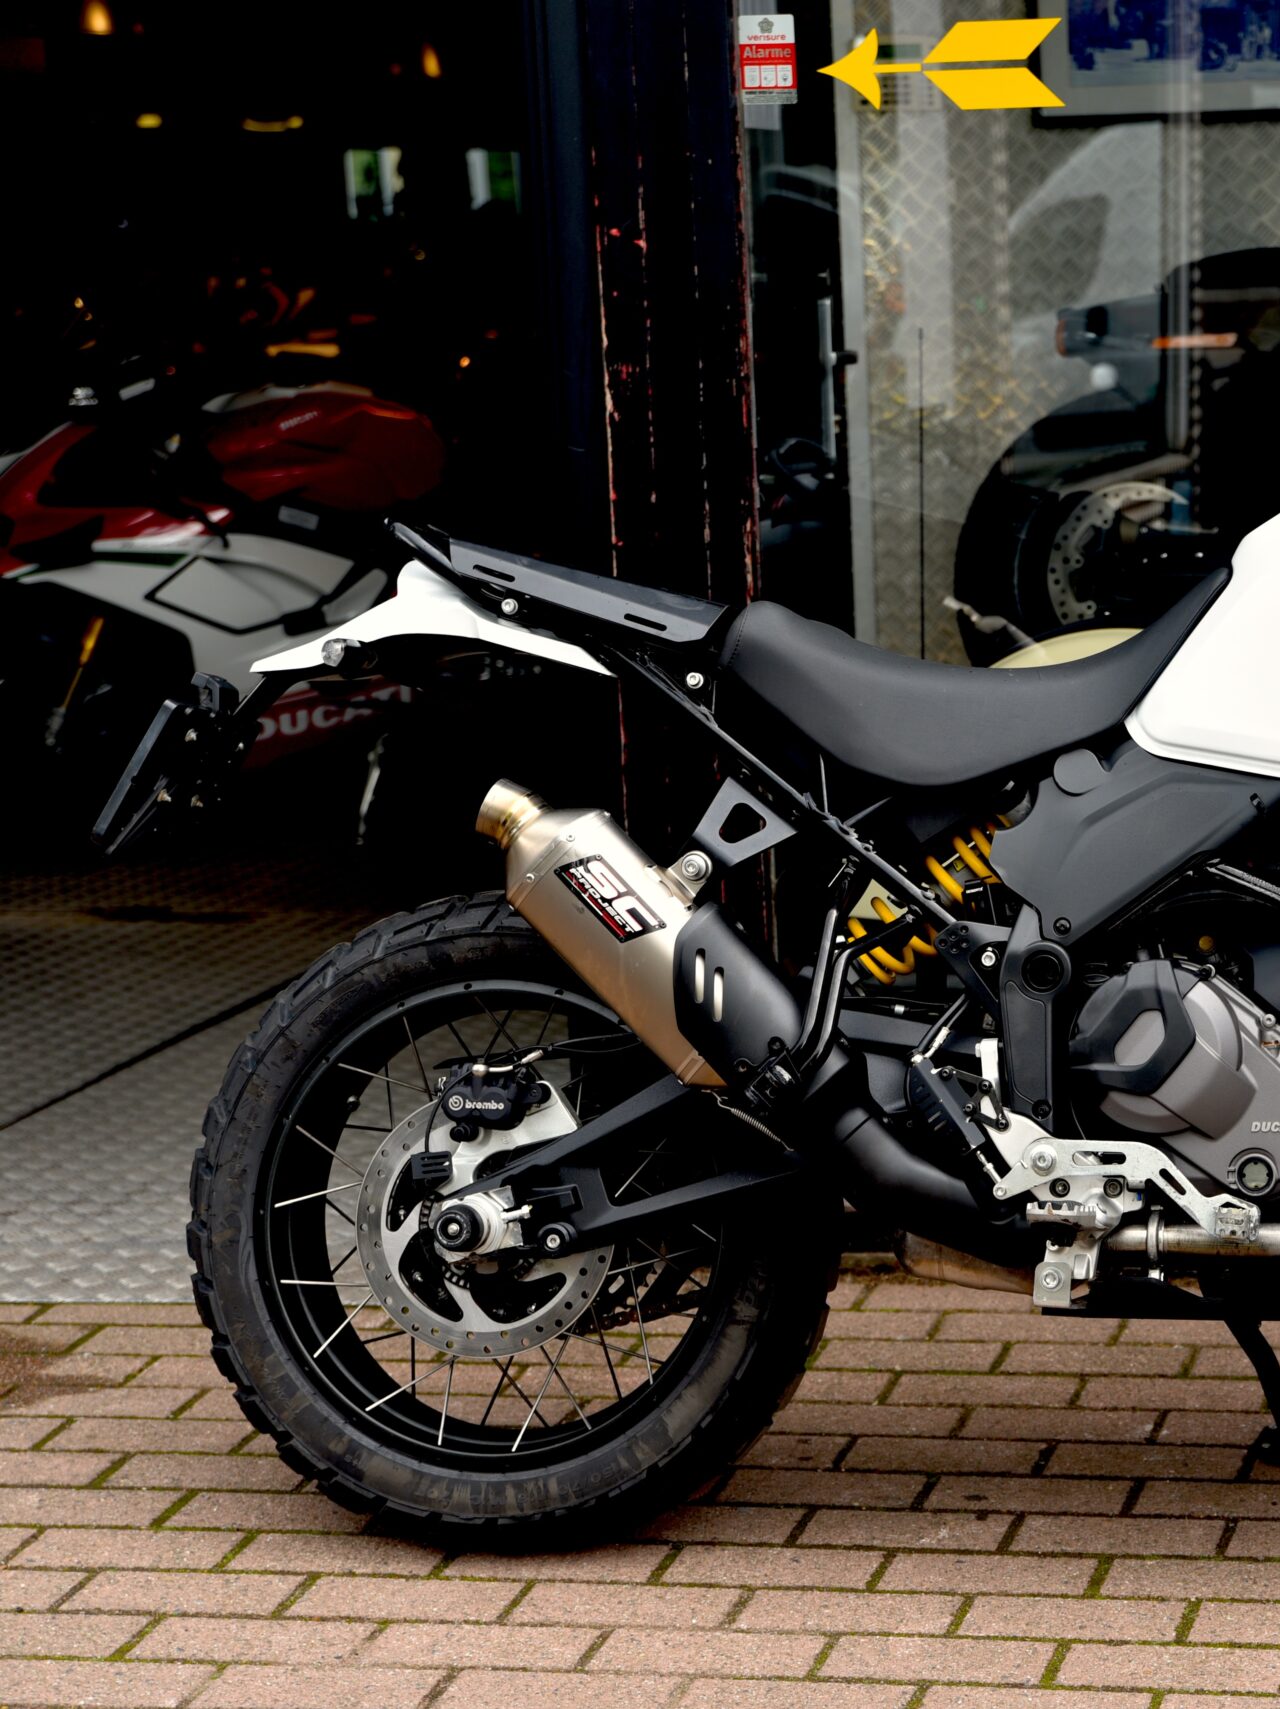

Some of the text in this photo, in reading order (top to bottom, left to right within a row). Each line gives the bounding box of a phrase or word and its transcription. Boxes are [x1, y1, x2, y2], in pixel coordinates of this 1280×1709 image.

[747, 33, 786, 41] verisure
[743, 45, 792, 58] Alarme
[569, 867, 635, 933] PROJECT
[587, 860, 660, 932] SC
[465, 1099, 505, 1110] brembo
